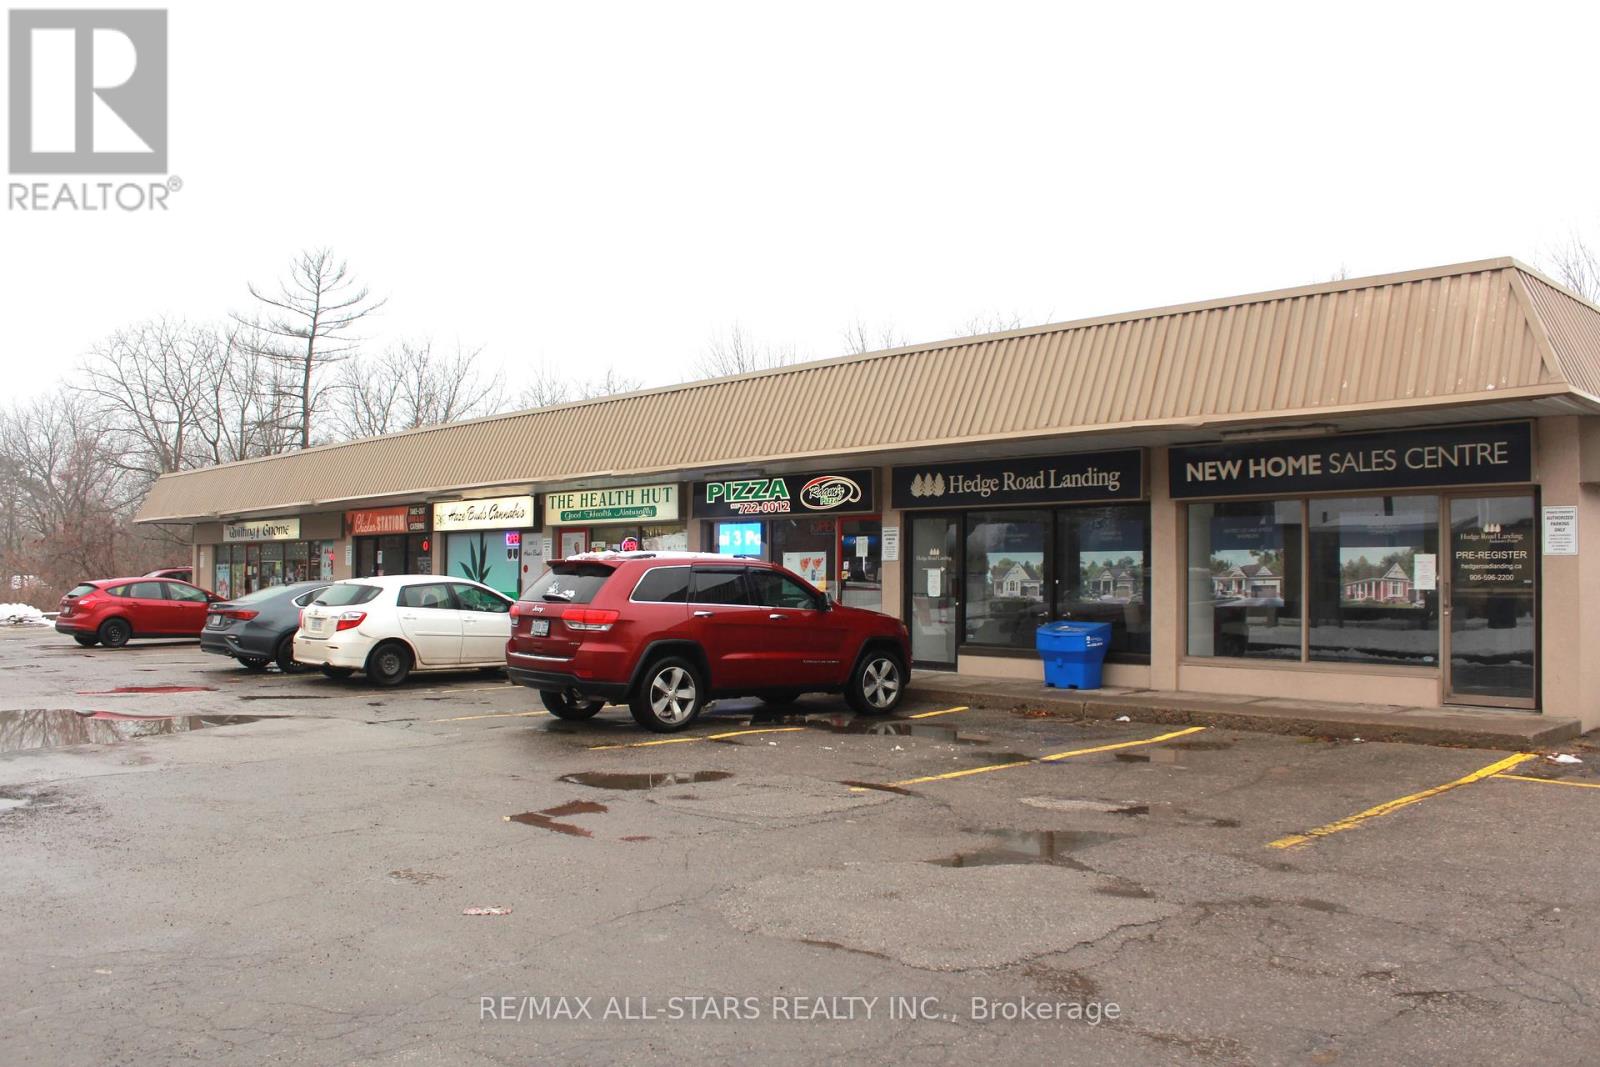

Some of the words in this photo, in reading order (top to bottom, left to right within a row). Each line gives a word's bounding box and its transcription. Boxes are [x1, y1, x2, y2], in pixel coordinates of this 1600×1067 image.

[1186, 459, 1242, 482] NEW
[1249, 454, 1322, 478] HOME
[1329, 449, 1397, 474] SALES
[1404, 441, 1508, 469] CENTRE
[949, 474, 1000, 497] Hedge
[1003, 471, 1044, 491] Road
[1048, 467, 1121, 492] Landing
[549, 494, 574, 510] THE
[580, 490, 634, 508] HEALTH
[641, 487, 672, 504] HUT
[706, 478, 791, 504] PIZZA
[489, 502, 525, 520] Cannabis
[564, 511, 581, 520] Good
[584, 510, 612, 518] Health
[614, 507, 653, 518] Naturally
[738, 500, 791, 514] 722-0012
[377, 515, 404, 532] STATION
[229, 526, 255, 539] Quilting
[734, 530, 741, 546] 3
[1498, 532, 1523, 541] Landing
[1456, 551, 1527, 559] PRE-REGISTER
